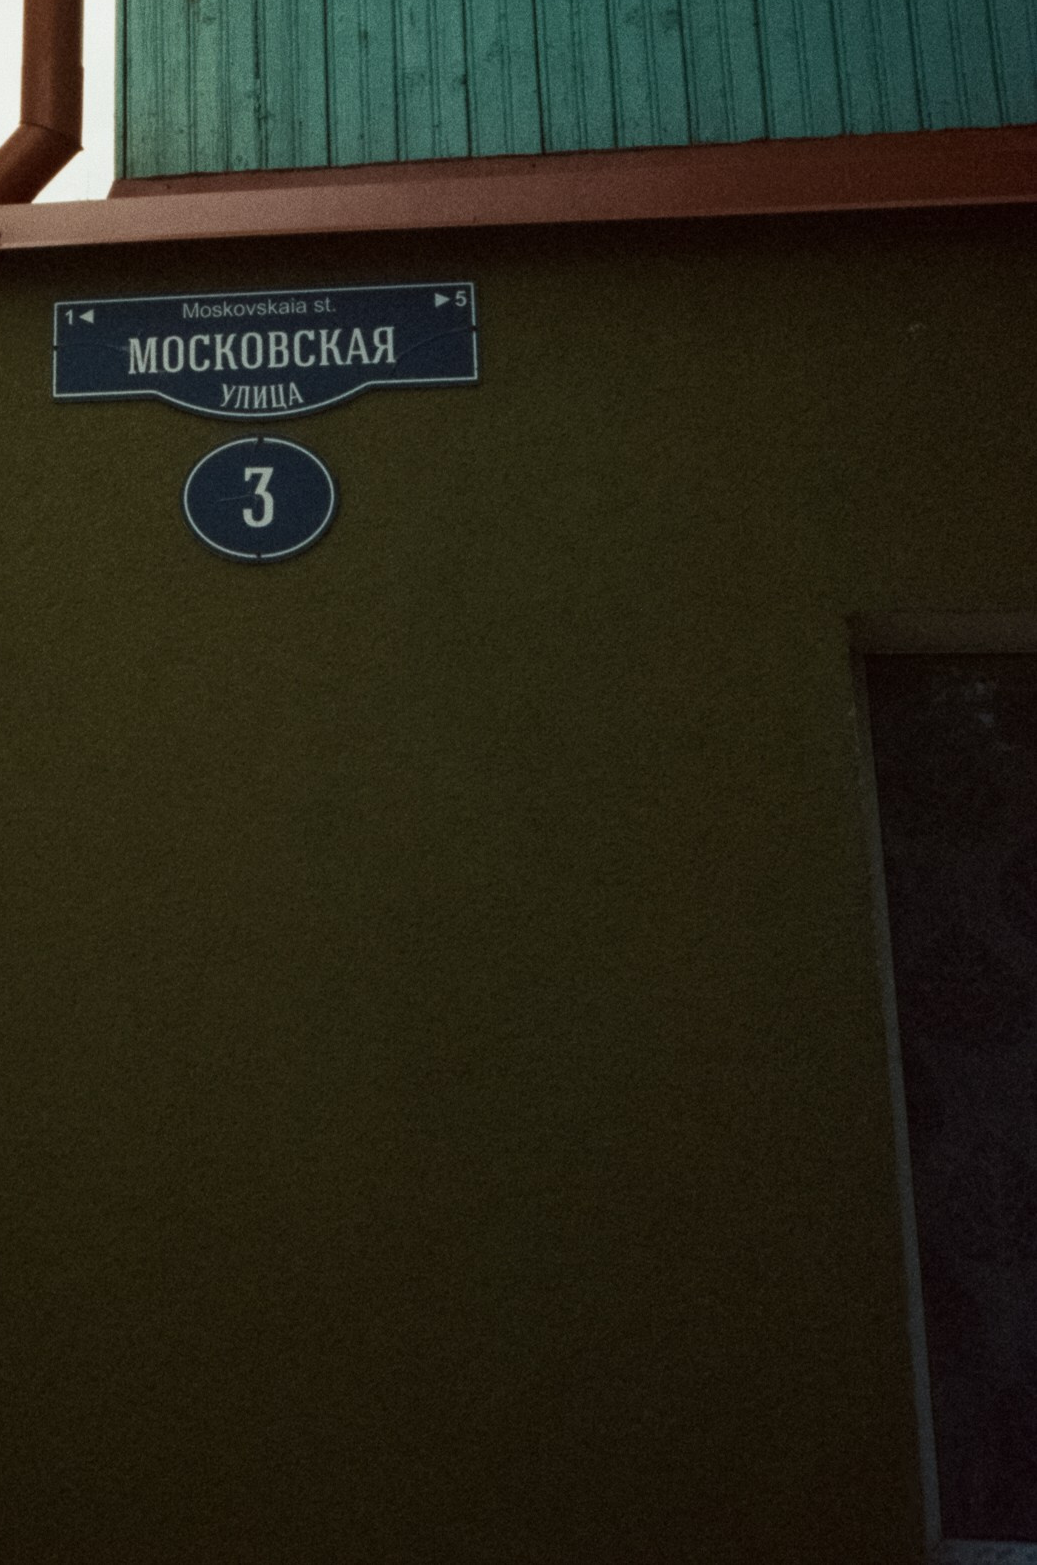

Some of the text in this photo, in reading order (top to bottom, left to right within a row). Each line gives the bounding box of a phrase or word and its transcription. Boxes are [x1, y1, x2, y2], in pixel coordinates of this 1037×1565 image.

[182, 296, 336, 319] Moskovskaia st.
[454, 290, 467, 307] 5
[65, 310, 75, 325] 1
[128, 326, 397, 375] МОСКОВСКАЯ
[219, 382, 303, 410] УЛИЦА
[242, 466, 274, 528] 3
